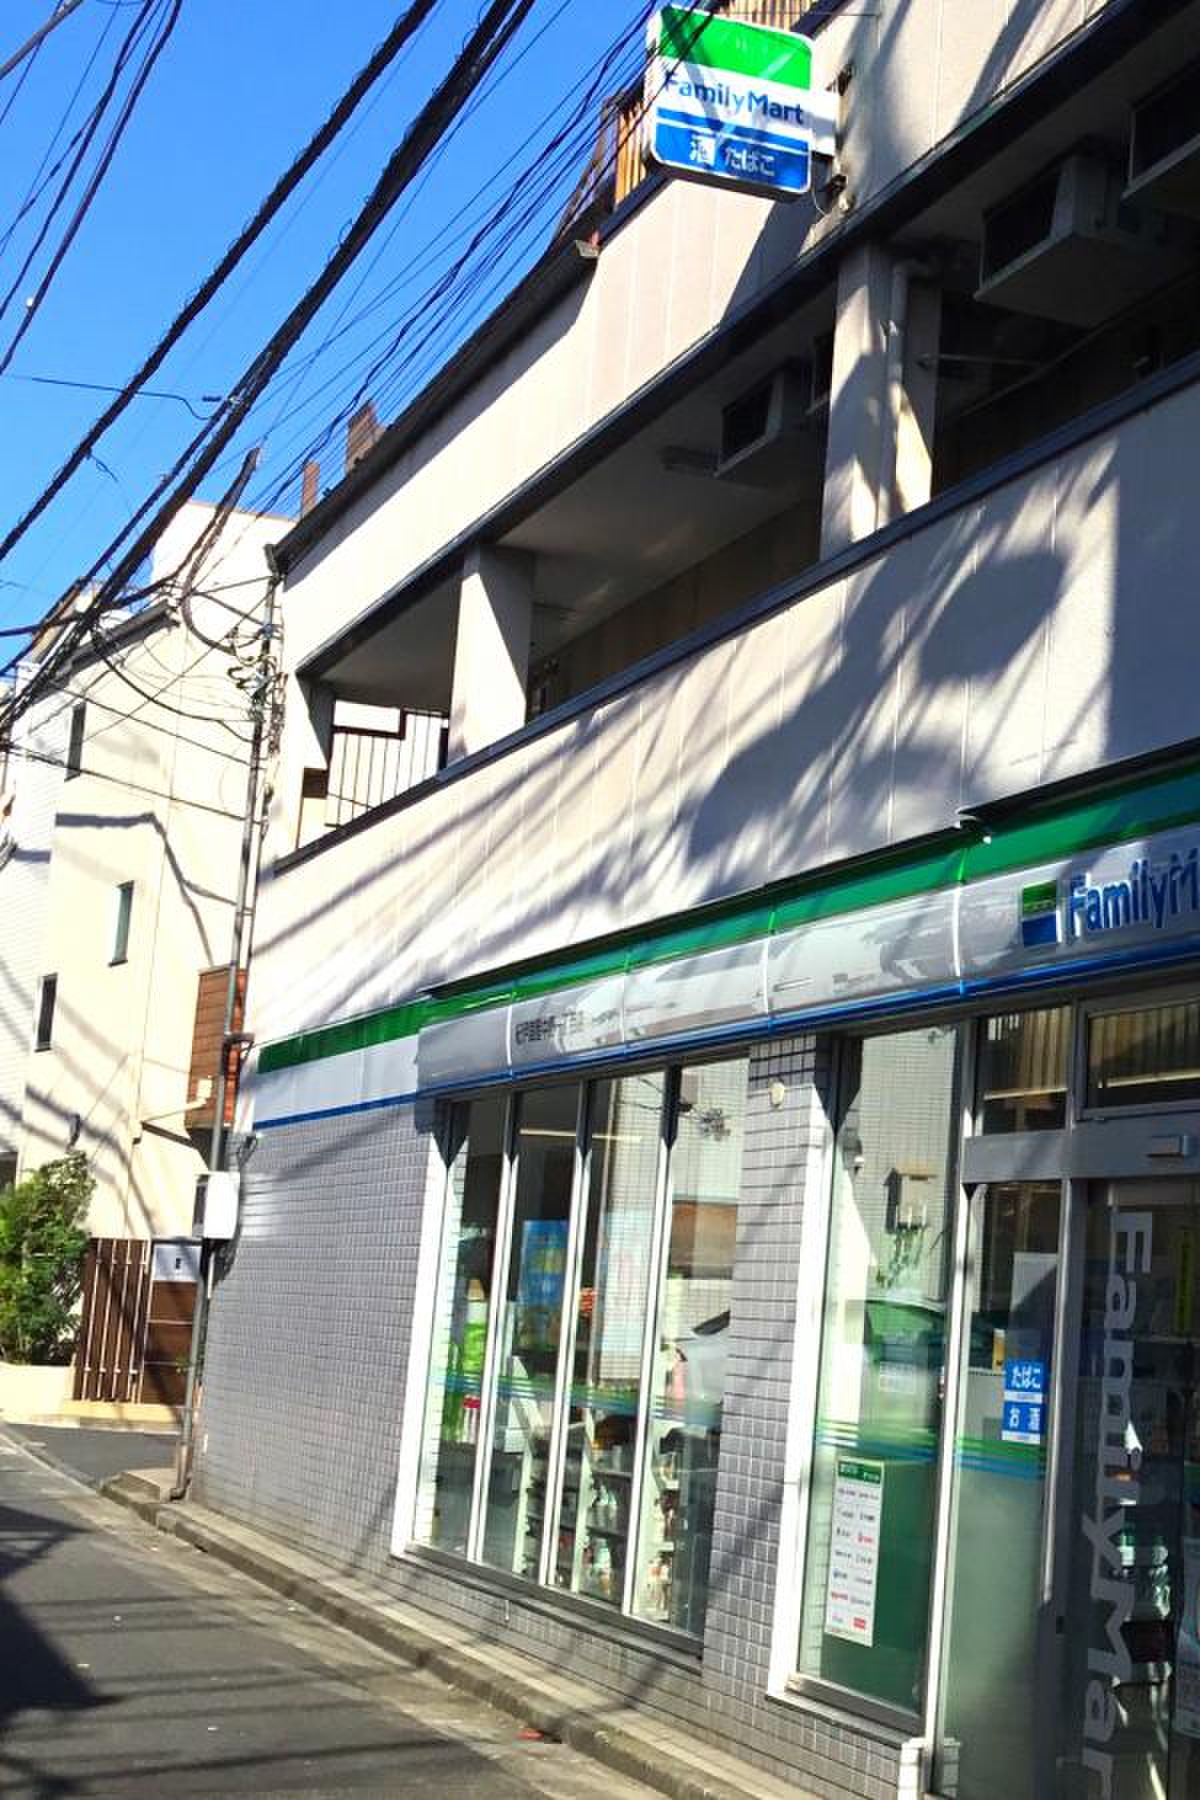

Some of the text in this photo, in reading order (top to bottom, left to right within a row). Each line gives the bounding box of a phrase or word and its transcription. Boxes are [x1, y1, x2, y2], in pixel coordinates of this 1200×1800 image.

[664, 70, 804, 125] FamilyMart
[724, 146, 776, 177] たばこ
[1011, 1365, 1041, 1389] たばこ
